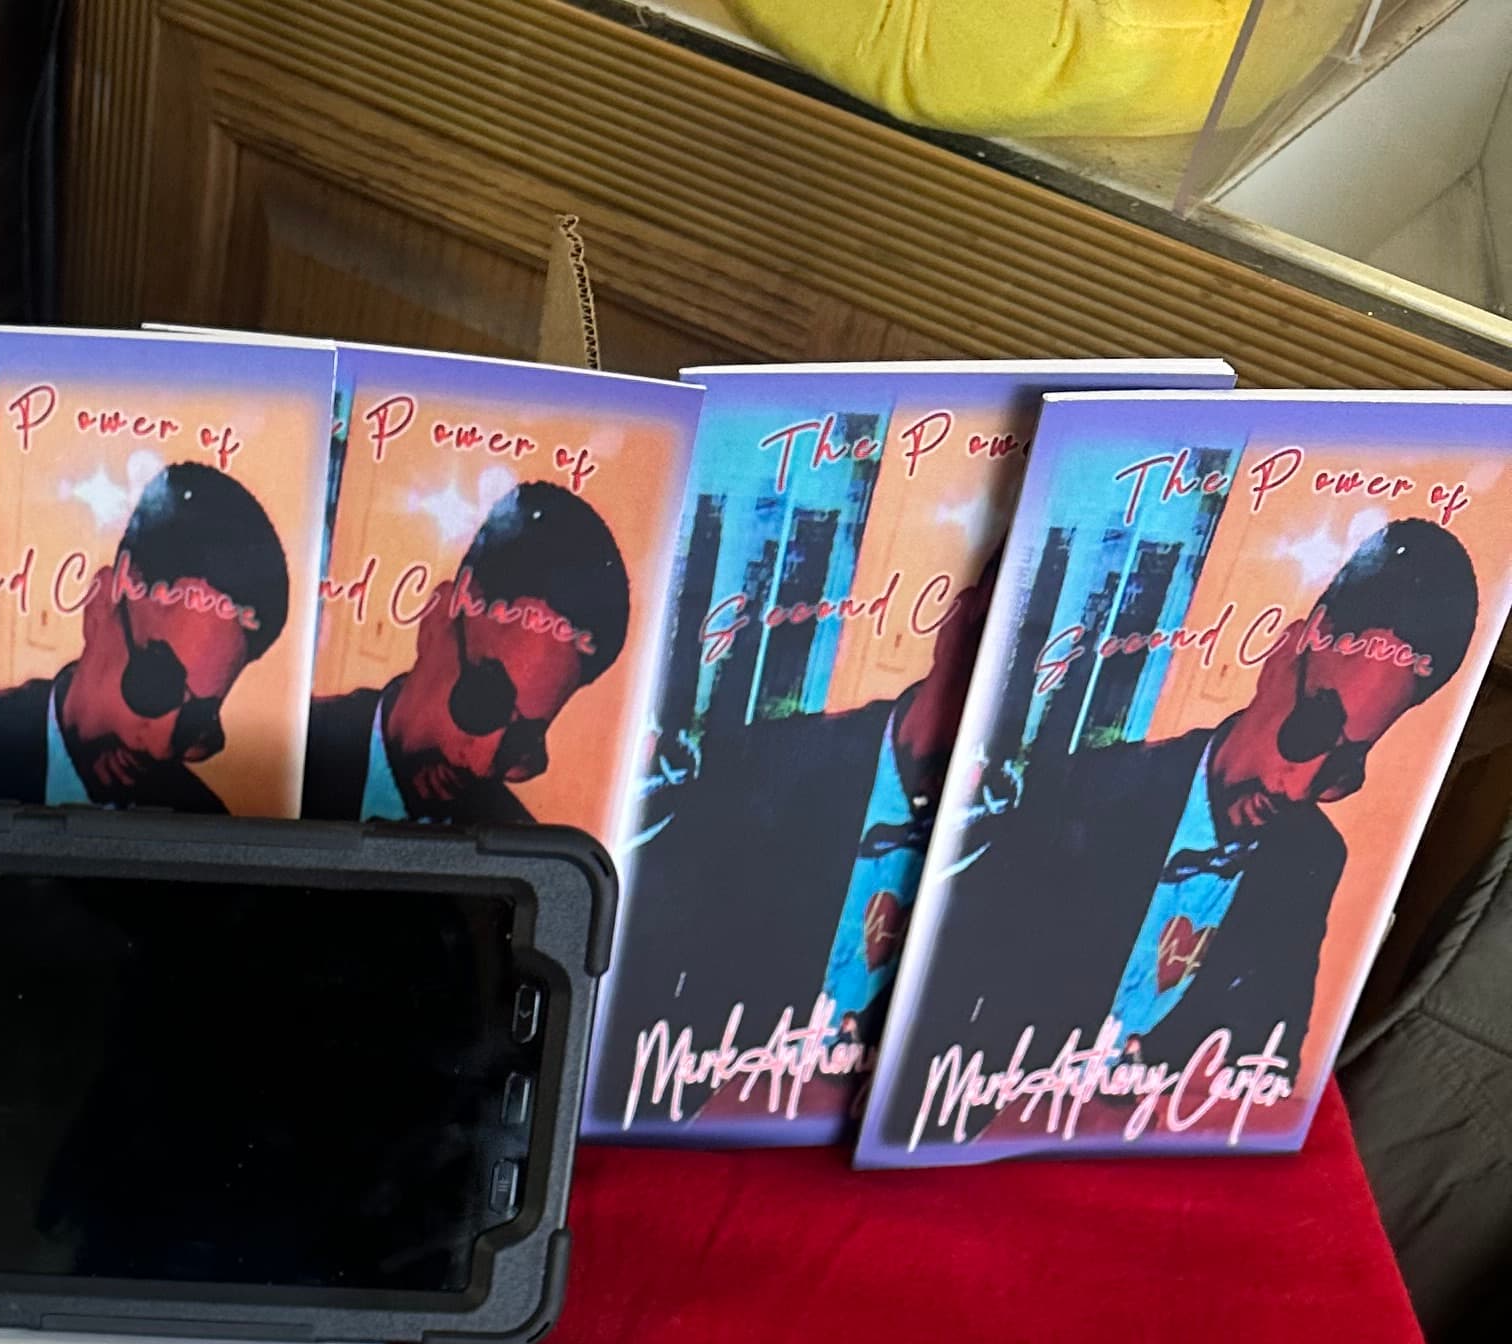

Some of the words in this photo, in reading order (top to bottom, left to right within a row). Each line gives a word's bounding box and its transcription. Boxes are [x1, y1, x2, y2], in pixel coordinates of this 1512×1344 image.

[200, 423, 243, 472] of
[554, 446, 595, 488] of
[1115, 449, 1226, 526] The
[1430, 486, 1469, 521] of
[1174, 1020, 1293, 1150] Carter
